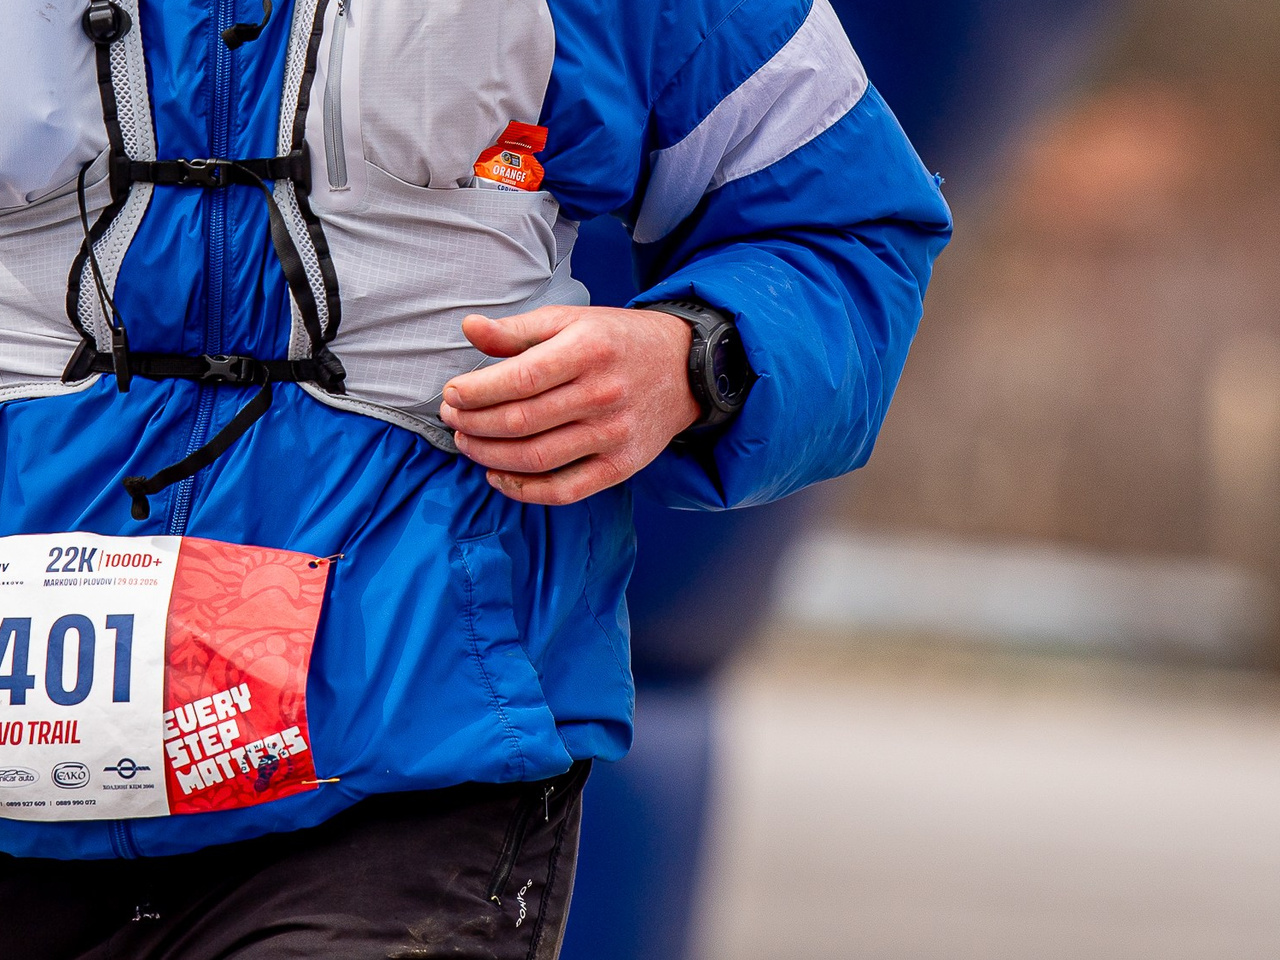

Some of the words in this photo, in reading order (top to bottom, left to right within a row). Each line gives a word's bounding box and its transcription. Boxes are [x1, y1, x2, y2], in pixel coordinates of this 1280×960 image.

[492, 165, 527, 183] ORANGE
[45, 546, 98, 573] 22K
[105, 553, 163, 568] 1000D+
[43, 578, 78, 586] MARKOVO
[83, 577, 113, 586] PLOVDIV
[163, 682, 252, 740] EVERY
[27, 720, 81, 745] TRAIL
[165, 719, 240, 769] STEP
[175, 725, 308, 795] MATTERS
[18, 774, 35, 782] auto
